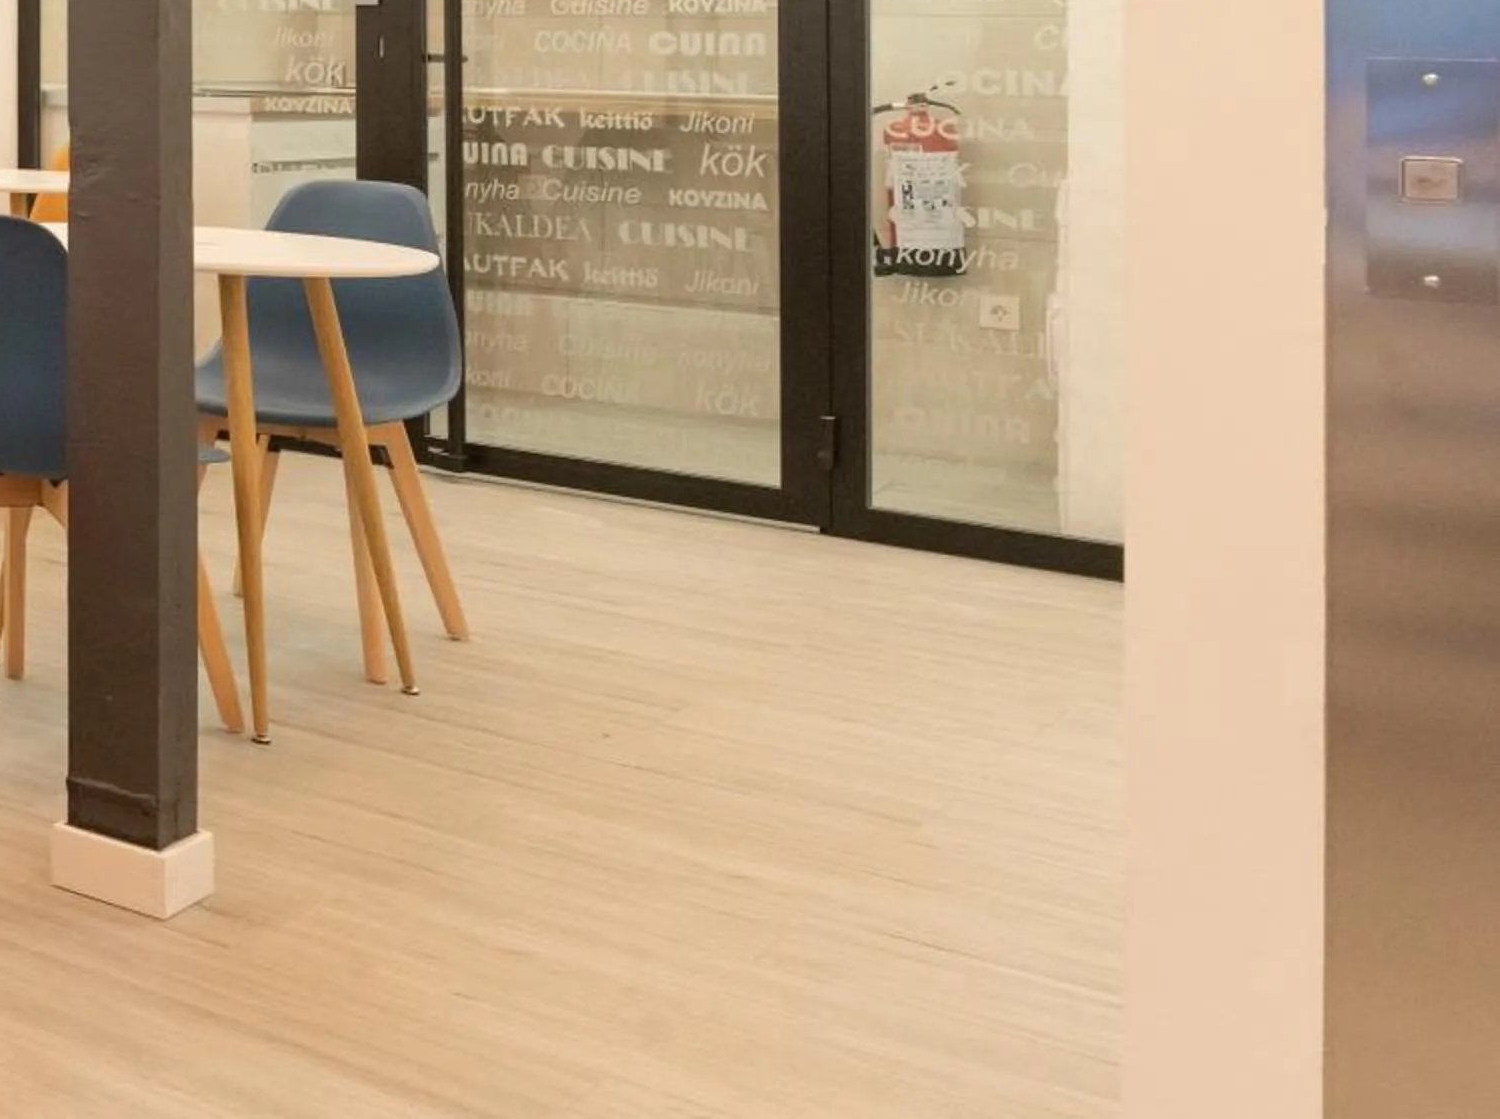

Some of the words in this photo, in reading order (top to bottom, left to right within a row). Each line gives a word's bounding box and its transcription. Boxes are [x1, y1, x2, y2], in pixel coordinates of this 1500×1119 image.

[648, 31, 768, 57] CUINA
[264, 96, 353, 115] KOVZINA
[679, 110, 755, 134] Jikoni
[885, 116, 1035, 142] CUCINA
[541, 145, 674, 174] CUISINE
[699, 143, 768, 179] kök
[464, 178, 520, 205] nyha
[543, 179, 643, 206] Cuisine
[668, 188, 768, 211] KOVZINA
[618, 220, 757, 253] CUISINE
[896, 245, 1020, 274] konyha
[684, 269, 761, 296] Jikoni
